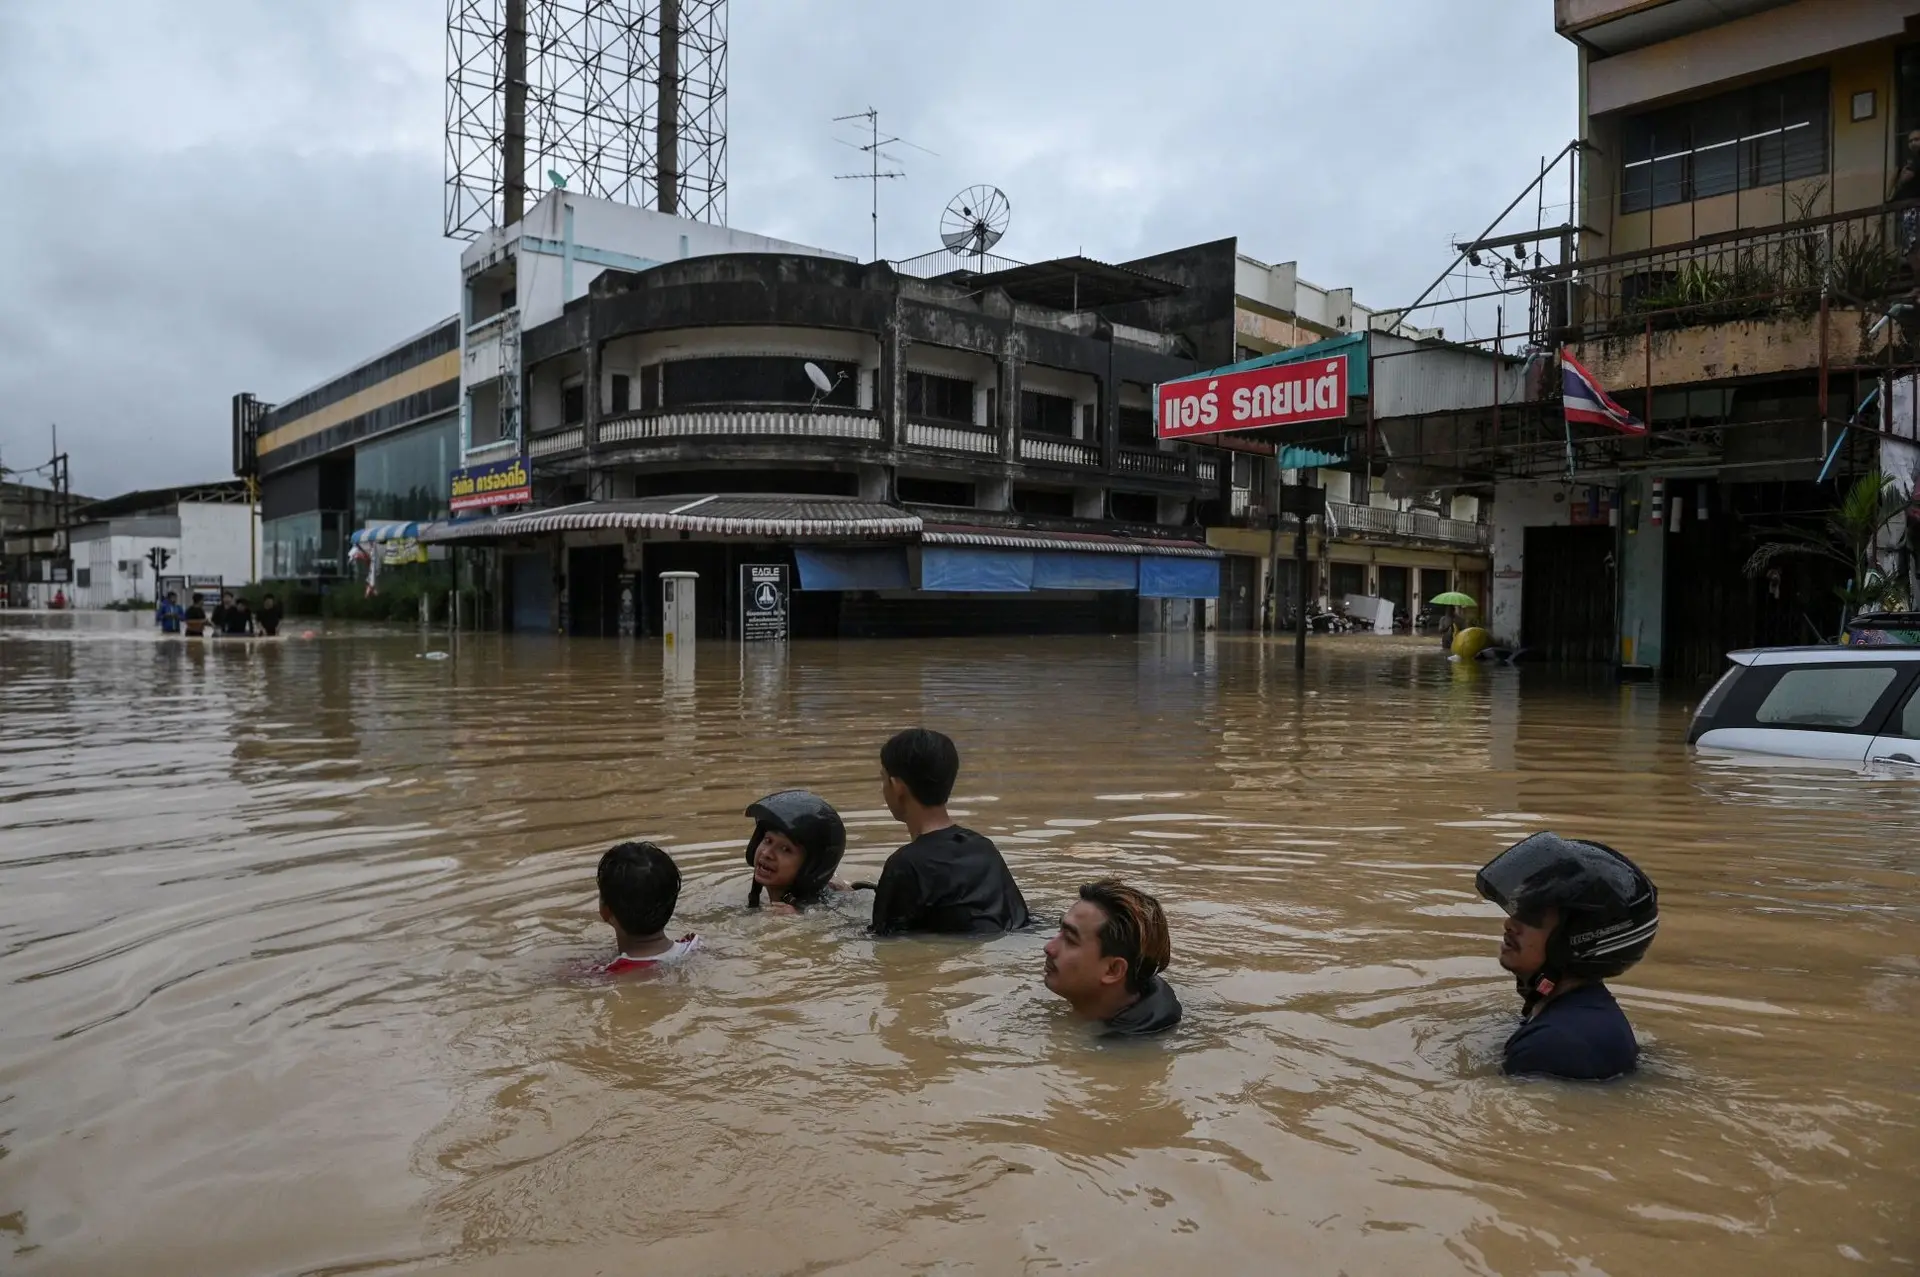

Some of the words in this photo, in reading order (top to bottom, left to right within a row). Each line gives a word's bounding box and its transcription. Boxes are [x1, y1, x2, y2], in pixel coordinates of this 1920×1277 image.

[1165, 380, 1218, 429] แอร์
[1232, 362, 1338, 421] รถยนต์
[751, 567, 780, 577] EAGLE
